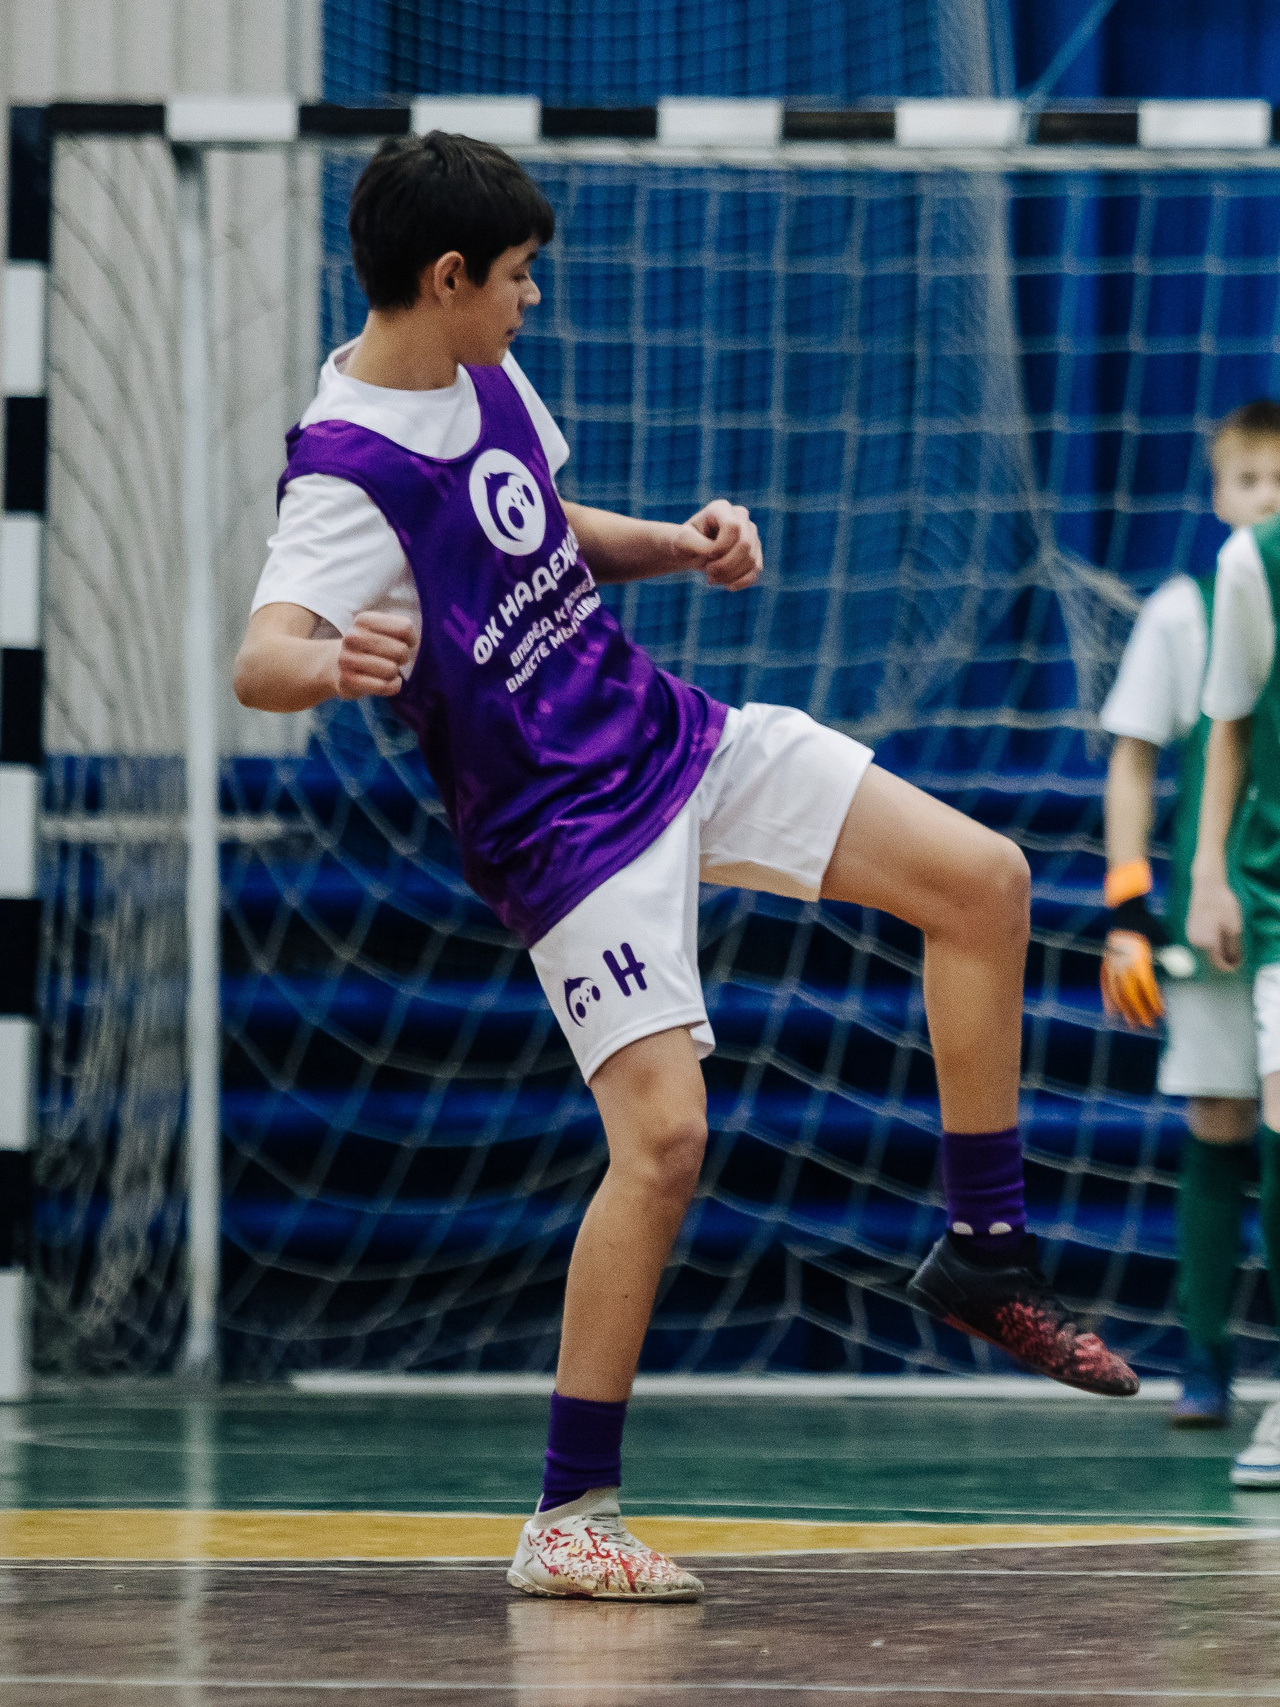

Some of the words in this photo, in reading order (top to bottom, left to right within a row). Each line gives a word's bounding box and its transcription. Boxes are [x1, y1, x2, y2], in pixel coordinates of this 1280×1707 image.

[473, 616, 505, 665] ФК
[499, 526, 579, 627] НАДЕЖ
[505, 641, 551, 694] ВМЕСТЕ
